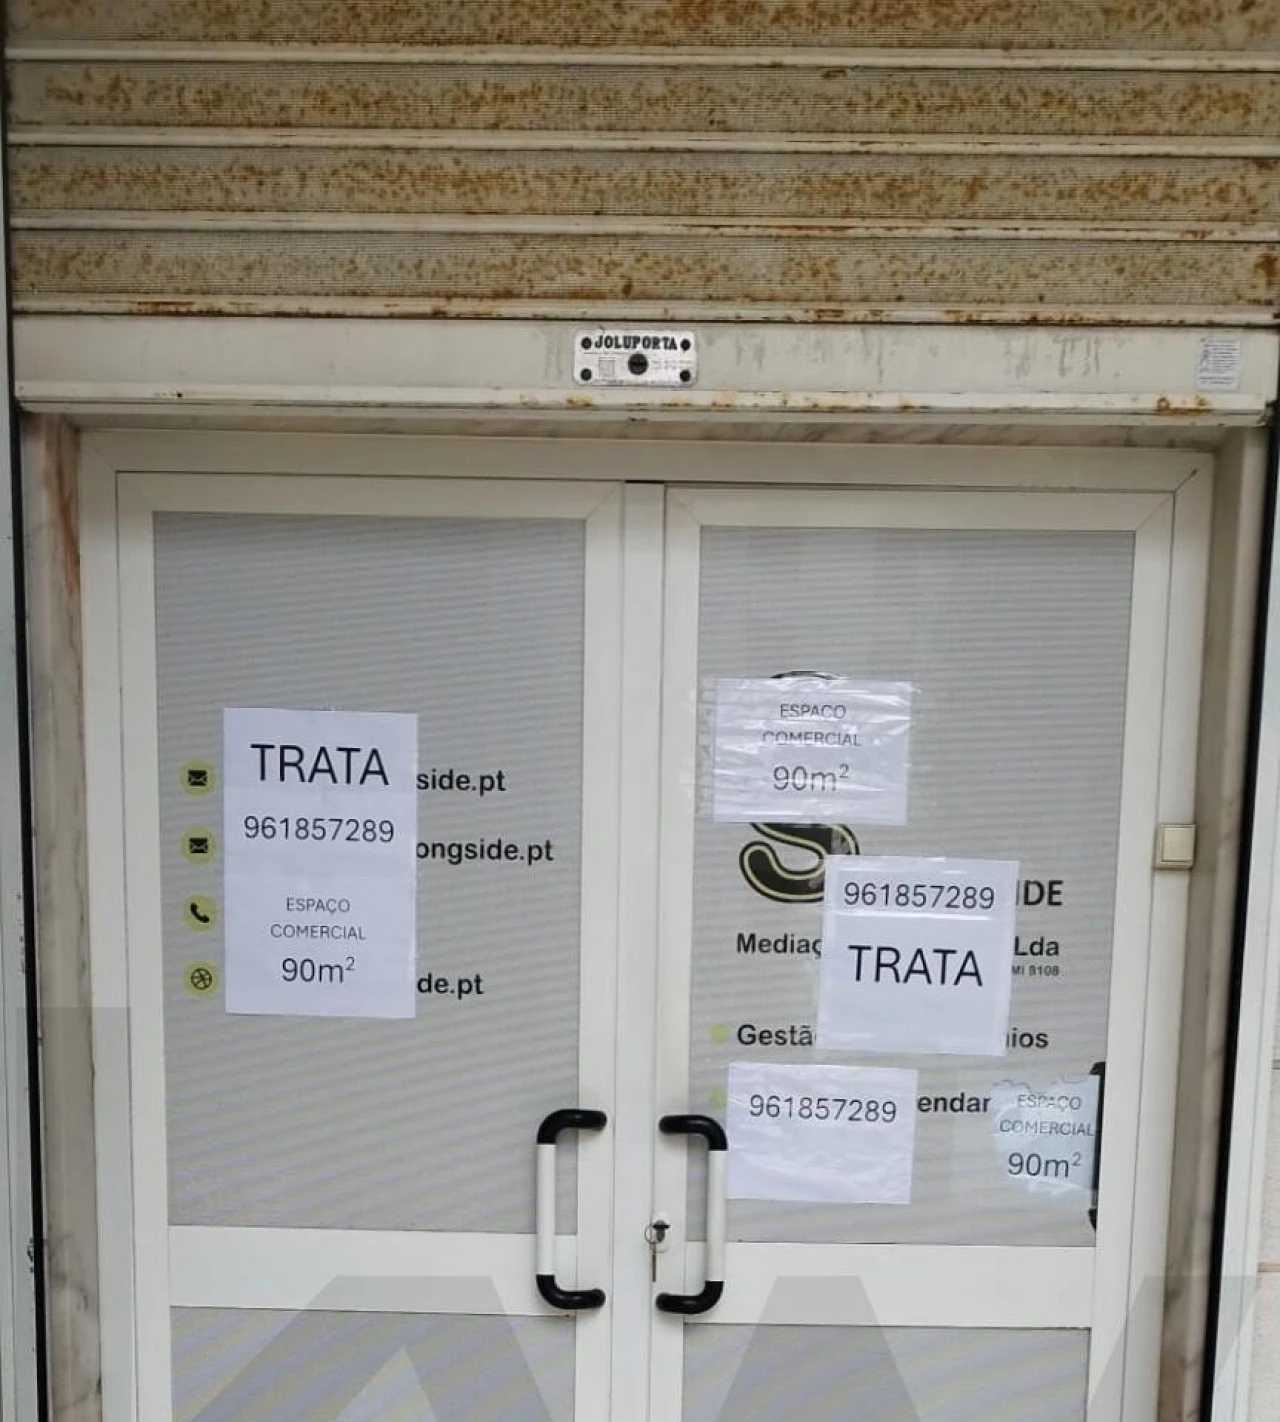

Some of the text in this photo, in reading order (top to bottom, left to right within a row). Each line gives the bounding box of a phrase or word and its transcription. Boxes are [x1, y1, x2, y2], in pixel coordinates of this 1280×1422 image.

[594, 335, 678, 351] JOLUPORTA
[762, 730, 861, 747] COMERCIAL
[250, 743, 390, 787] TRATA
[416, 768, 506, 797] side.pt
[243, 815, 395, 843] 961857289
[416, 838, 554, 866] ongside.pt
[286, 897, 351, 915] ESPAÇO
[844, 882, 995, 910] 961857289
[270, 923, 367, 941] COMERCIAL
[737, 932, 1060, 959] Mediaç Lda
[848, 944, 984, 987] TRATA
[416, 972, 484, 1001] de.pt
[737, 1023, 817, 1047] Gestã
[749, 1094, 897, 1123] 961857289
[917, 1092, 991, 1113] endar
[999, 1119, 1096, 1137] COMERCIAL
